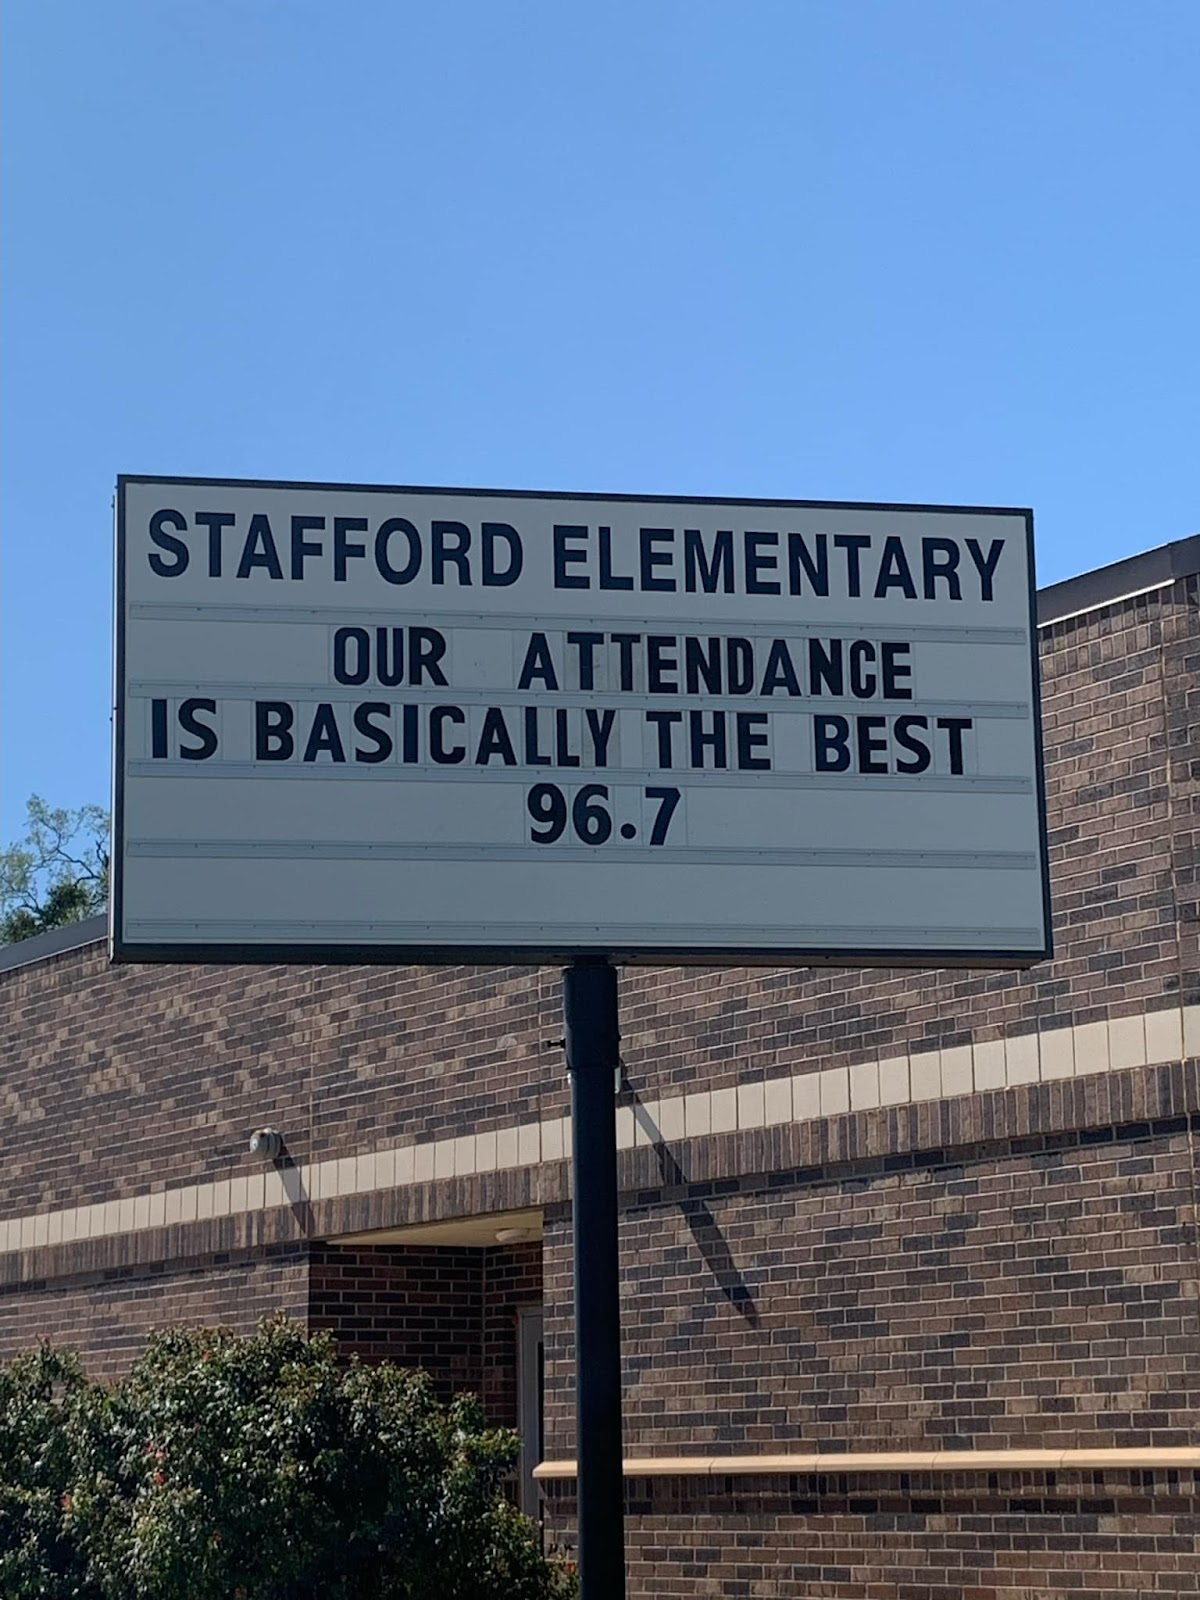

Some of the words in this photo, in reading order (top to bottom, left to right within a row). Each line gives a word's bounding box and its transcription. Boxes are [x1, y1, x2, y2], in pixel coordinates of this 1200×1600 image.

[147, 508, 524, 587] STAFFORD
[552, 524, 1006, 602] ELEMENTARY
[333, 625, 450, 688] OUR
[517, 630, 913, 701] ATTENDANCE
[151, 697, 219, 761] IS
[254, 700, 617, 768] BASICALLY
[645, 709, 772, 771] THE
[813, 713, 973, 776] BEST
[527, 782, 682, 846] 96.7
